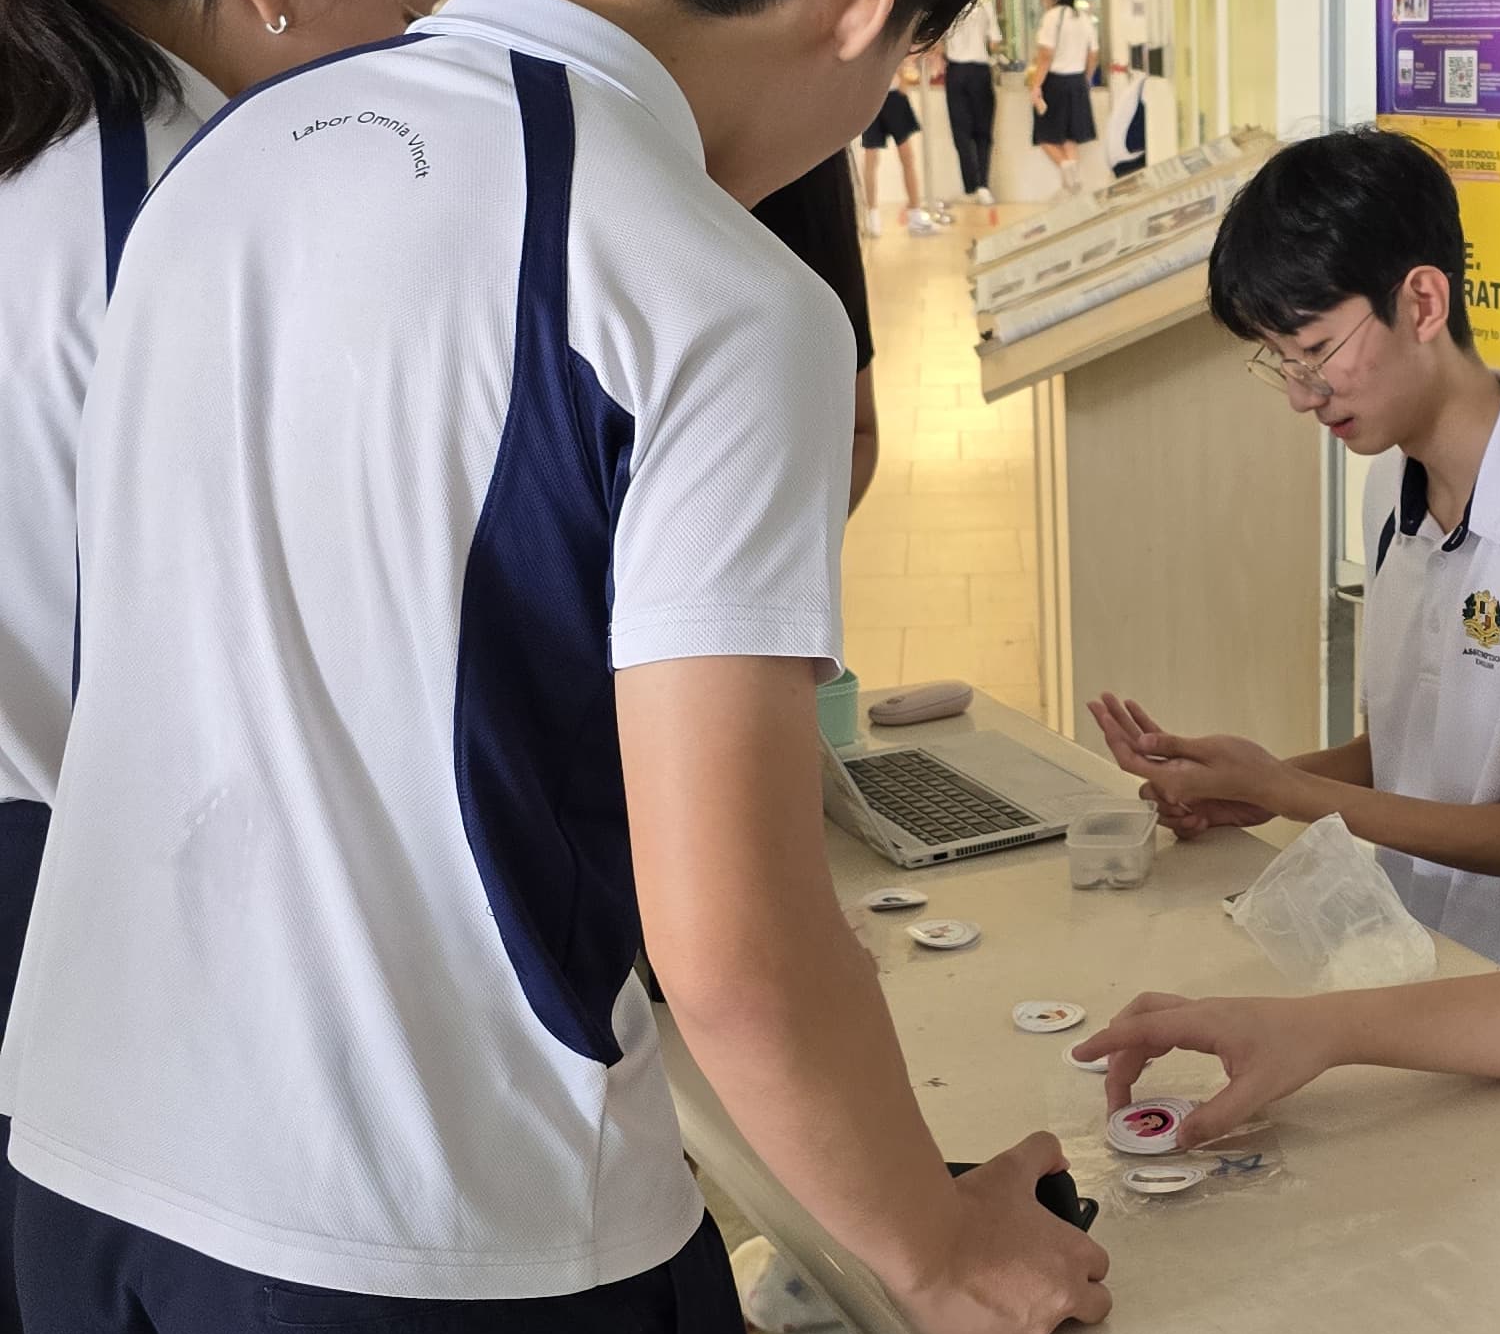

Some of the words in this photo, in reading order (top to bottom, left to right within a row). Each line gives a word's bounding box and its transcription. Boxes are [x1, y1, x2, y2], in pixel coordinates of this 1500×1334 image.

[291, 115, 353, 142] Labor
[357, 110, 411, 138] Omnia
[407, 133, 431, 179] Vincit
